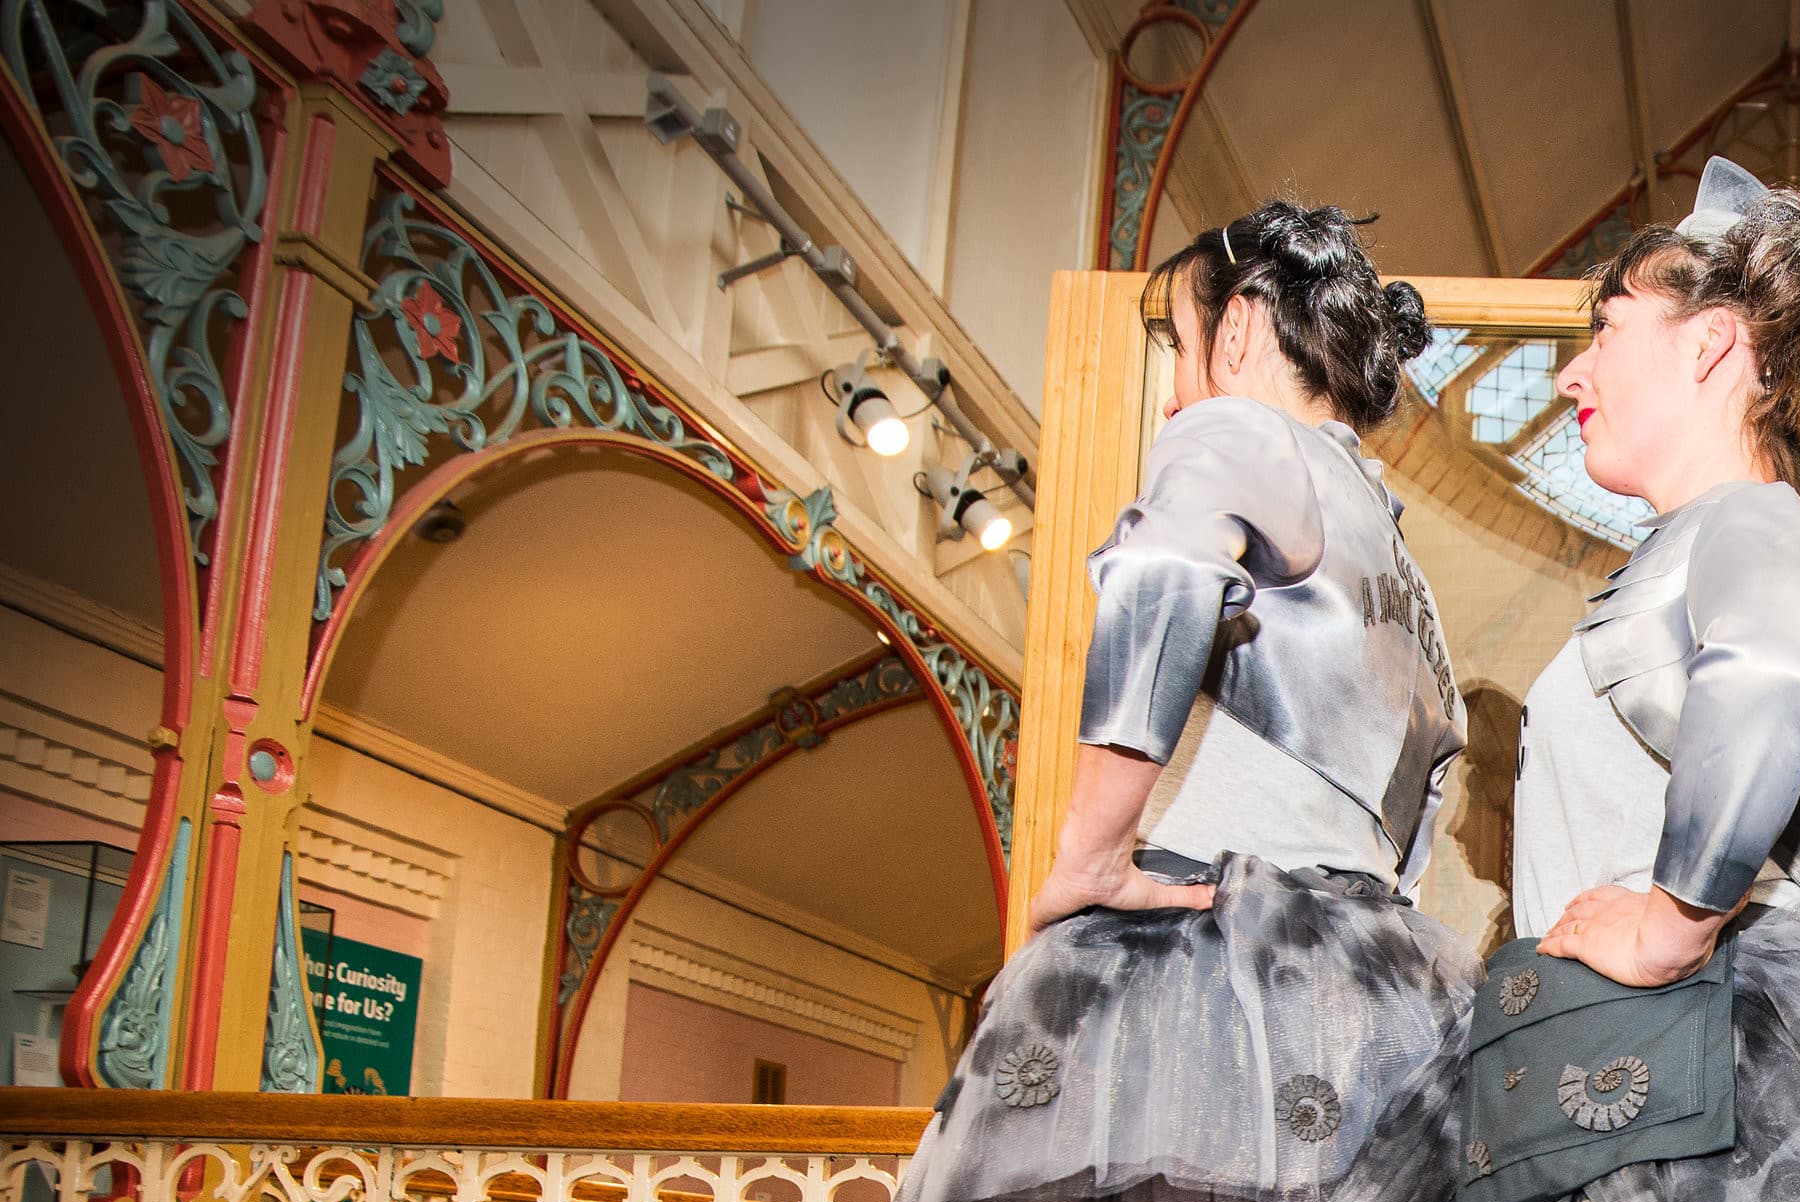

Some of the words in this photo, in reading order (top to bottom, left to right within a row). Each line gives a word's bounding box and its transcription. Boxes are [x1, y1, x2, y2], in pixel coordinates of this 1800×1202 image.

[336, 962, 407, 1002] Curiosity
[337, 992, 361, 1015] for
[363, 996, 394, 1022] Us?
